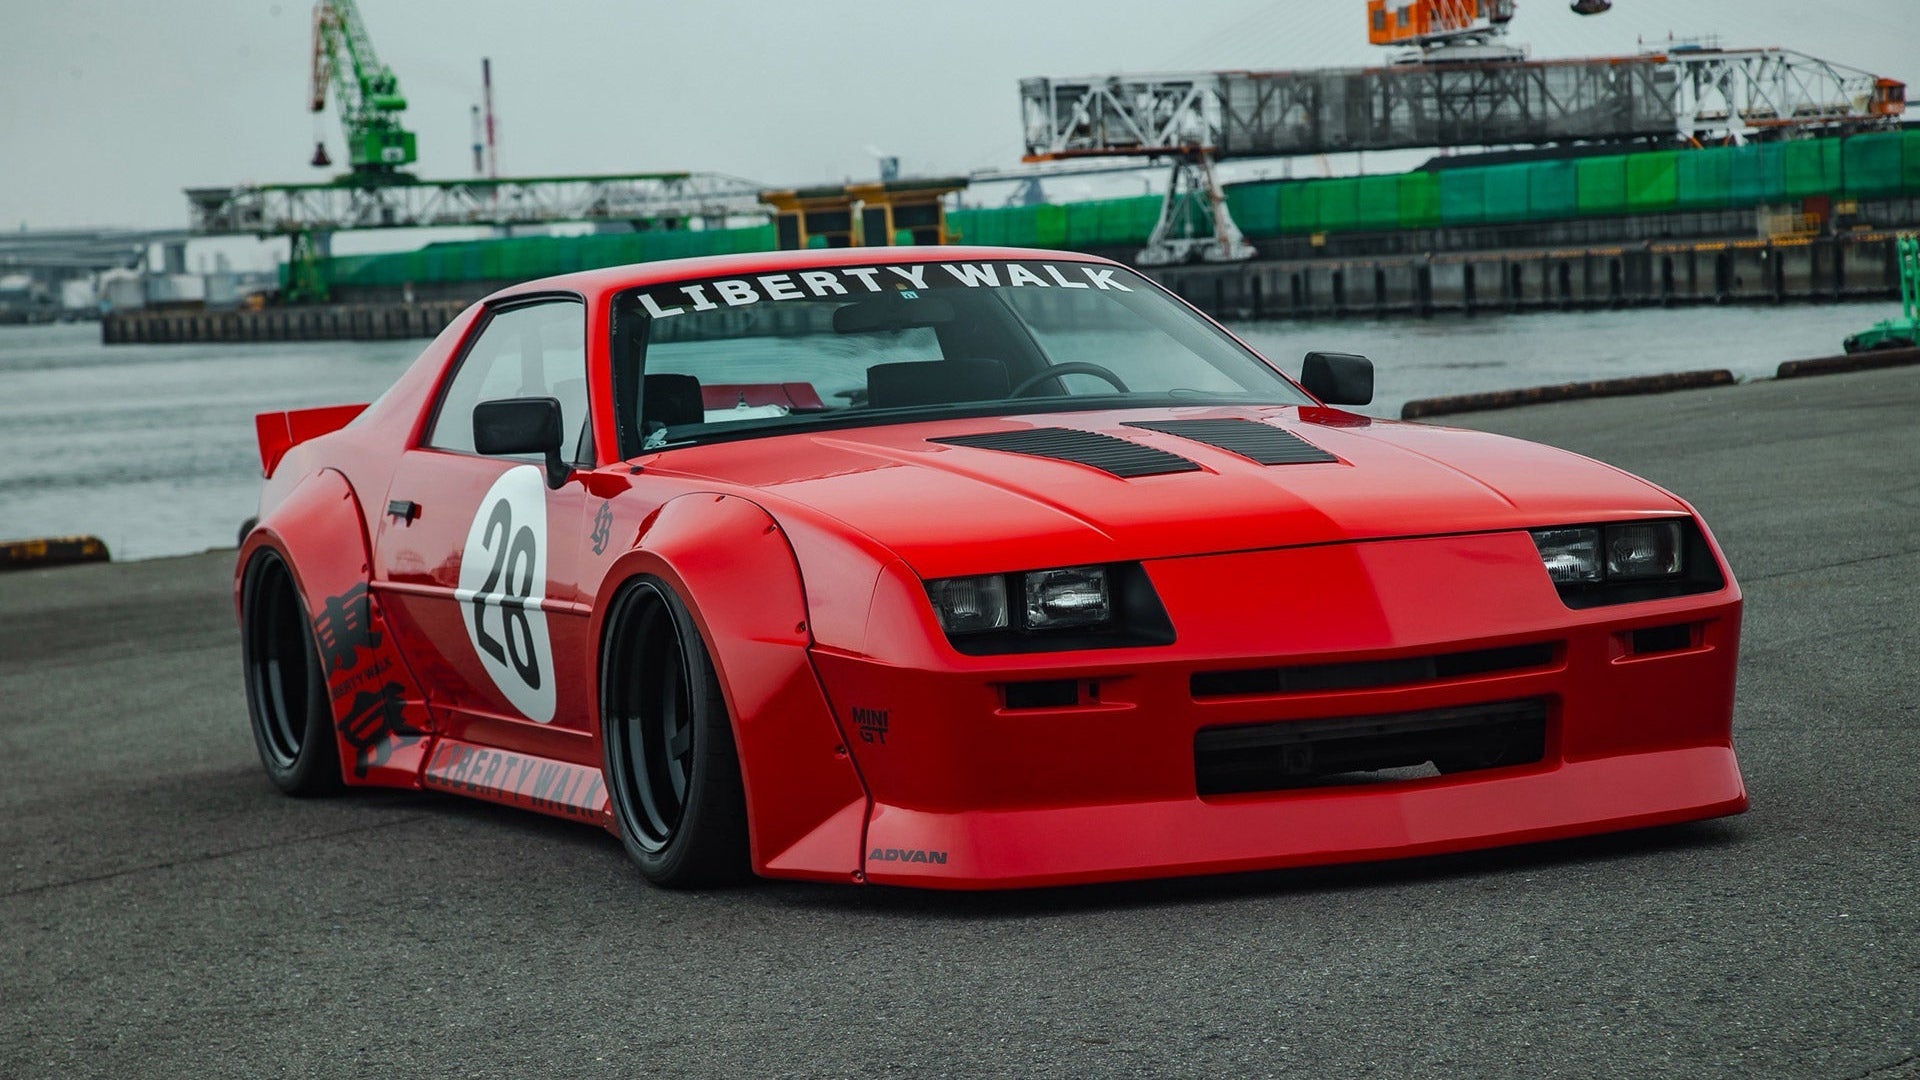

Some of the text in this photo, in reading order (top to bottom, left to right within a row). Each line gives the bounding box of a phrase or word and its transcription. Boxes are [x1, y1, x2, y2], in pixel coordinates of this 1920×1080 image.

[637, 263, 1134, 320] LIBERTY WALK
[474, 498, 541, 691] 28
[852, 706, 888, 726] MINI
[860, 725, 888, 744] GT
[426, 742, 601, 818] LIBERTY WALK
[868, 848, 947, 864] ADVAN
